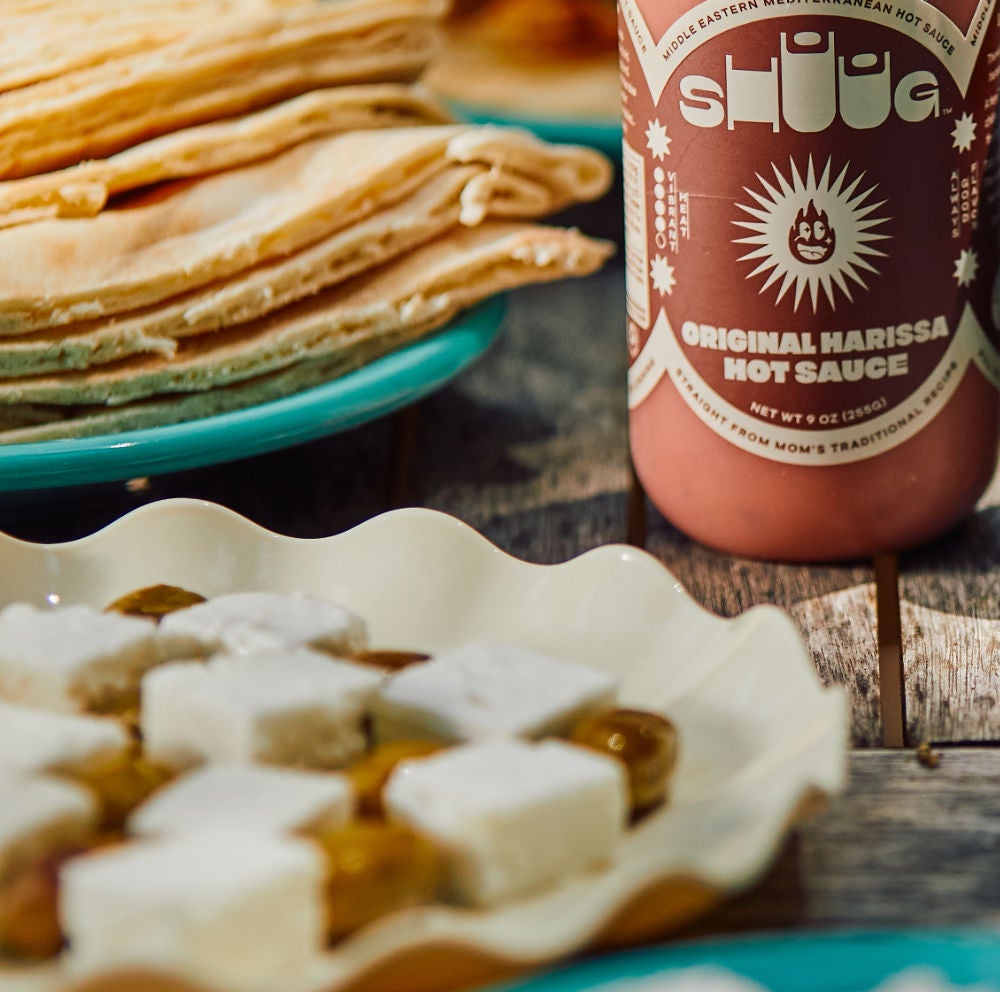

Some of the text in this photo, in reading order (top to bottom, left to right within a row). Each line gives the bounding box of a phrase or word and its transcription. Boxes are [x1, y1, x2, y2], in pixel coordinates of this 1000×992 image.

[662, 23, 699, 62] MIDDLE
[698, 0, 758, 29] EASTERN
[896, 9, 922, 28] HOT
[922, 22, 956, 57] SAUCE
[667, 171, 677, 252] VIBRANT
[679, 192, 688, 237] HEAT
[961, 177, 969, 223] GOOD
[680, 315, 949, 356] ORIGINAL HARISSA
[723, 353, 909, 384] HOT SAUCE
[675, 367, 728, 426] STRAIGHT
[730, 422, 770, 447] FROM
[774, 440, 826, 455] MOM'S
[830, 407, 923, 454] TRADITIONAL
[923, 359, 959, 408] RECIPE
[750, 400, 778, 420] NET
[780, 412, 803, 425] WT
[806, 413, 816, 425] 9
[818, 412, 839, 425] OZ
